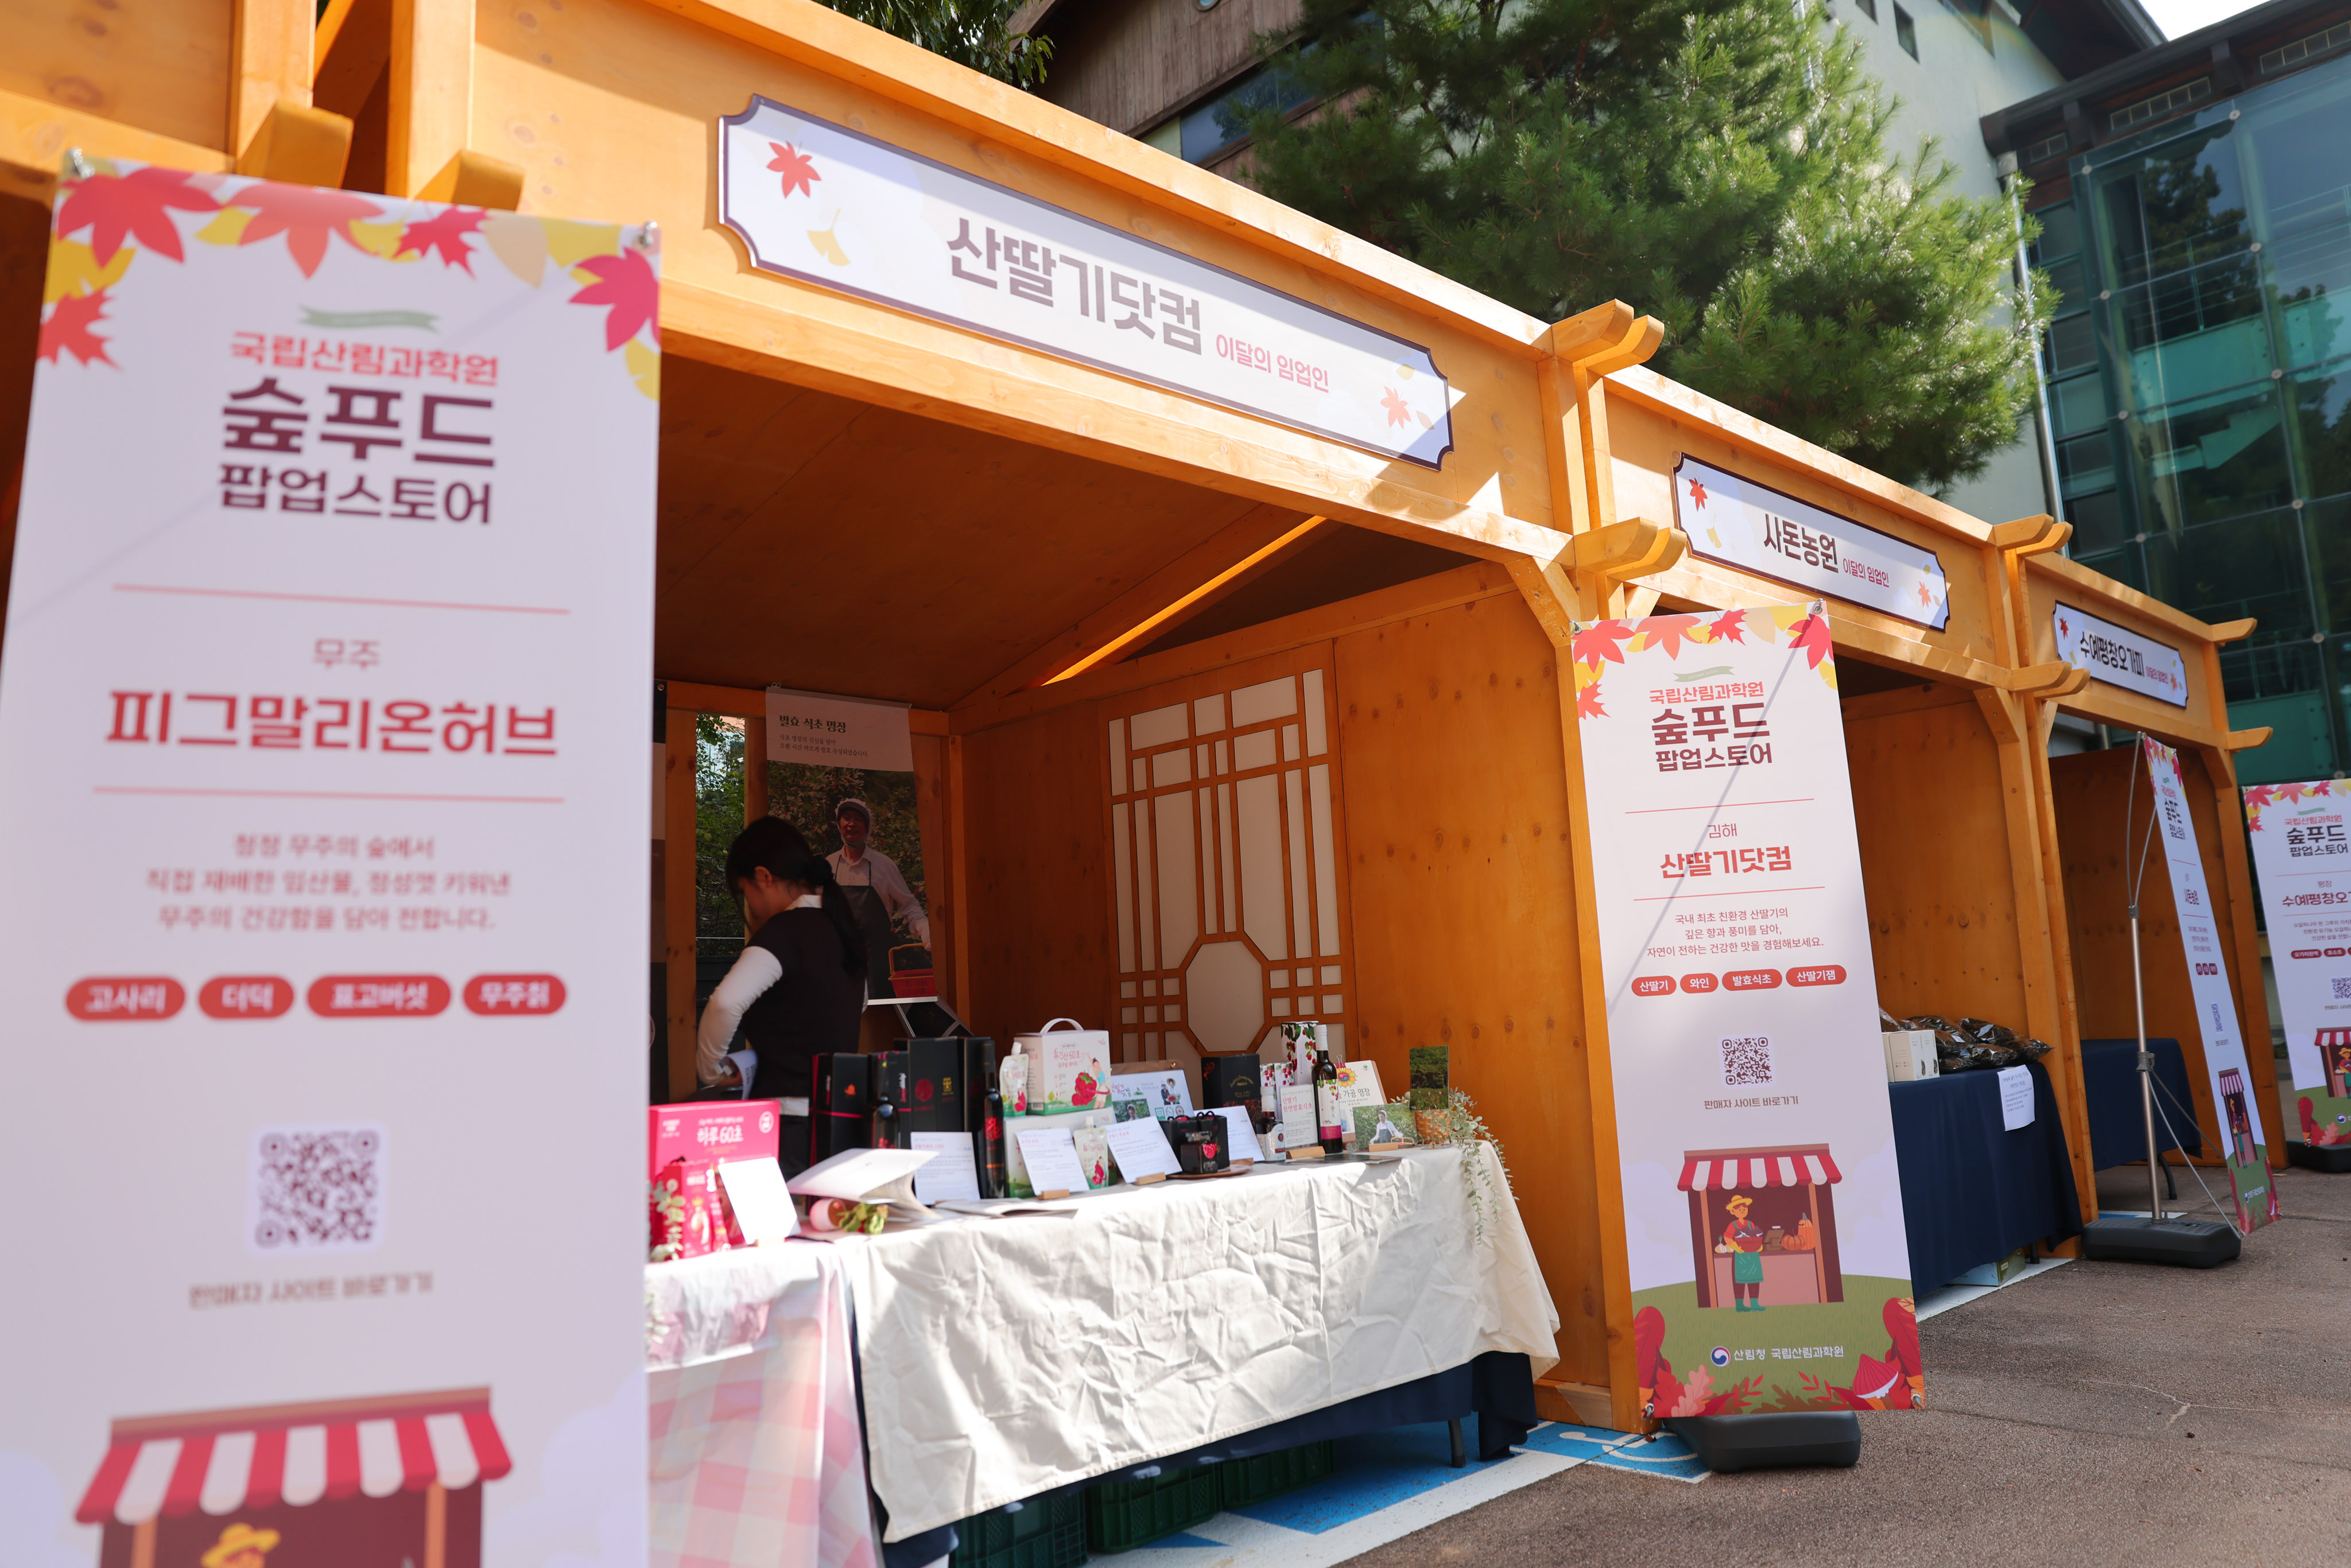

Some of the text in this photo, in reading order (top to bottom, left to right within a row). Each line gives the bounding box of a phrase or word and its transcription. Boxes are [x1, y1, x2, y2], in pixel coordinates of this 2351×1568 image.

[948, 216, 1330, 394] 산딸기닷컴 이달의 임업인
[230, 331, 499, 387] 국립산림과학원
[223, 377, 495, 468] 숲푸드
[219, 463, 492, 525] 팝업스토어
[1764, 513, 1890, 588] 사돈농원 이달의 임업인
[312, 639, 382, 671] 무주
[2080, 631, 2144, 677] 수예평창오가피
[1649, 681, 1764, 704] 국립산림과학원
[106, 689, 558, 756] 피그말리온허브
[779, 715, 847, 733] 발효 식초 명장
[1652, 703, 1770, 745] 숲푸드
[832, 748, 869, 758] 숙성되었습니다.
[1656, 743, 1772, 772] 팝업스토어
[1707, 823, 1737, 838] 김해
[2284, 815, 2342, 825] 국립산림과학원
[2287, 825, 2346, 845] 숲푸드
[289, 835, 359, 858] 무주의
[367, 836, 434, 860] 숲에서
[2290, 843, 2349, 857] 팝업스토어
[1660, 846, 1791, 879] 산딸기닷컴
[146, 869, 195, 894] 직접
[203, 869, 274, 894] 재배한
[2282, 891, 2351, 907] 수예평창오
[399, 907, 495, 931] 전합니다.
[1675, 907, 1789, 924] 국내 최초 친환경 산딸기의
[1685, 923, 1782, 940] 깊은 향과 풍미를 담아,
[1646, 936, 1824, 958] 자연이 전하는 건강한 맛을 경험해보세요.
[1639, 980, 1669, 992] 산딸기
[1689, 977, 1710, 989] 와인
[1732, 973, 1772, 987] 발효식초
[1797, 969, 1836, 983] 산딸기잼
[86, 983, 166, 1014] 고사리
[331, 981, 428, 1010] 표고버섯
[1343, 1088, 1370, 1097] 가공 명장
[1704, 1095, 1799, 1110] 판매자 사이트 바로가기
[1733, 1345, 1844, 1361] 산림청 국립산림과학원
